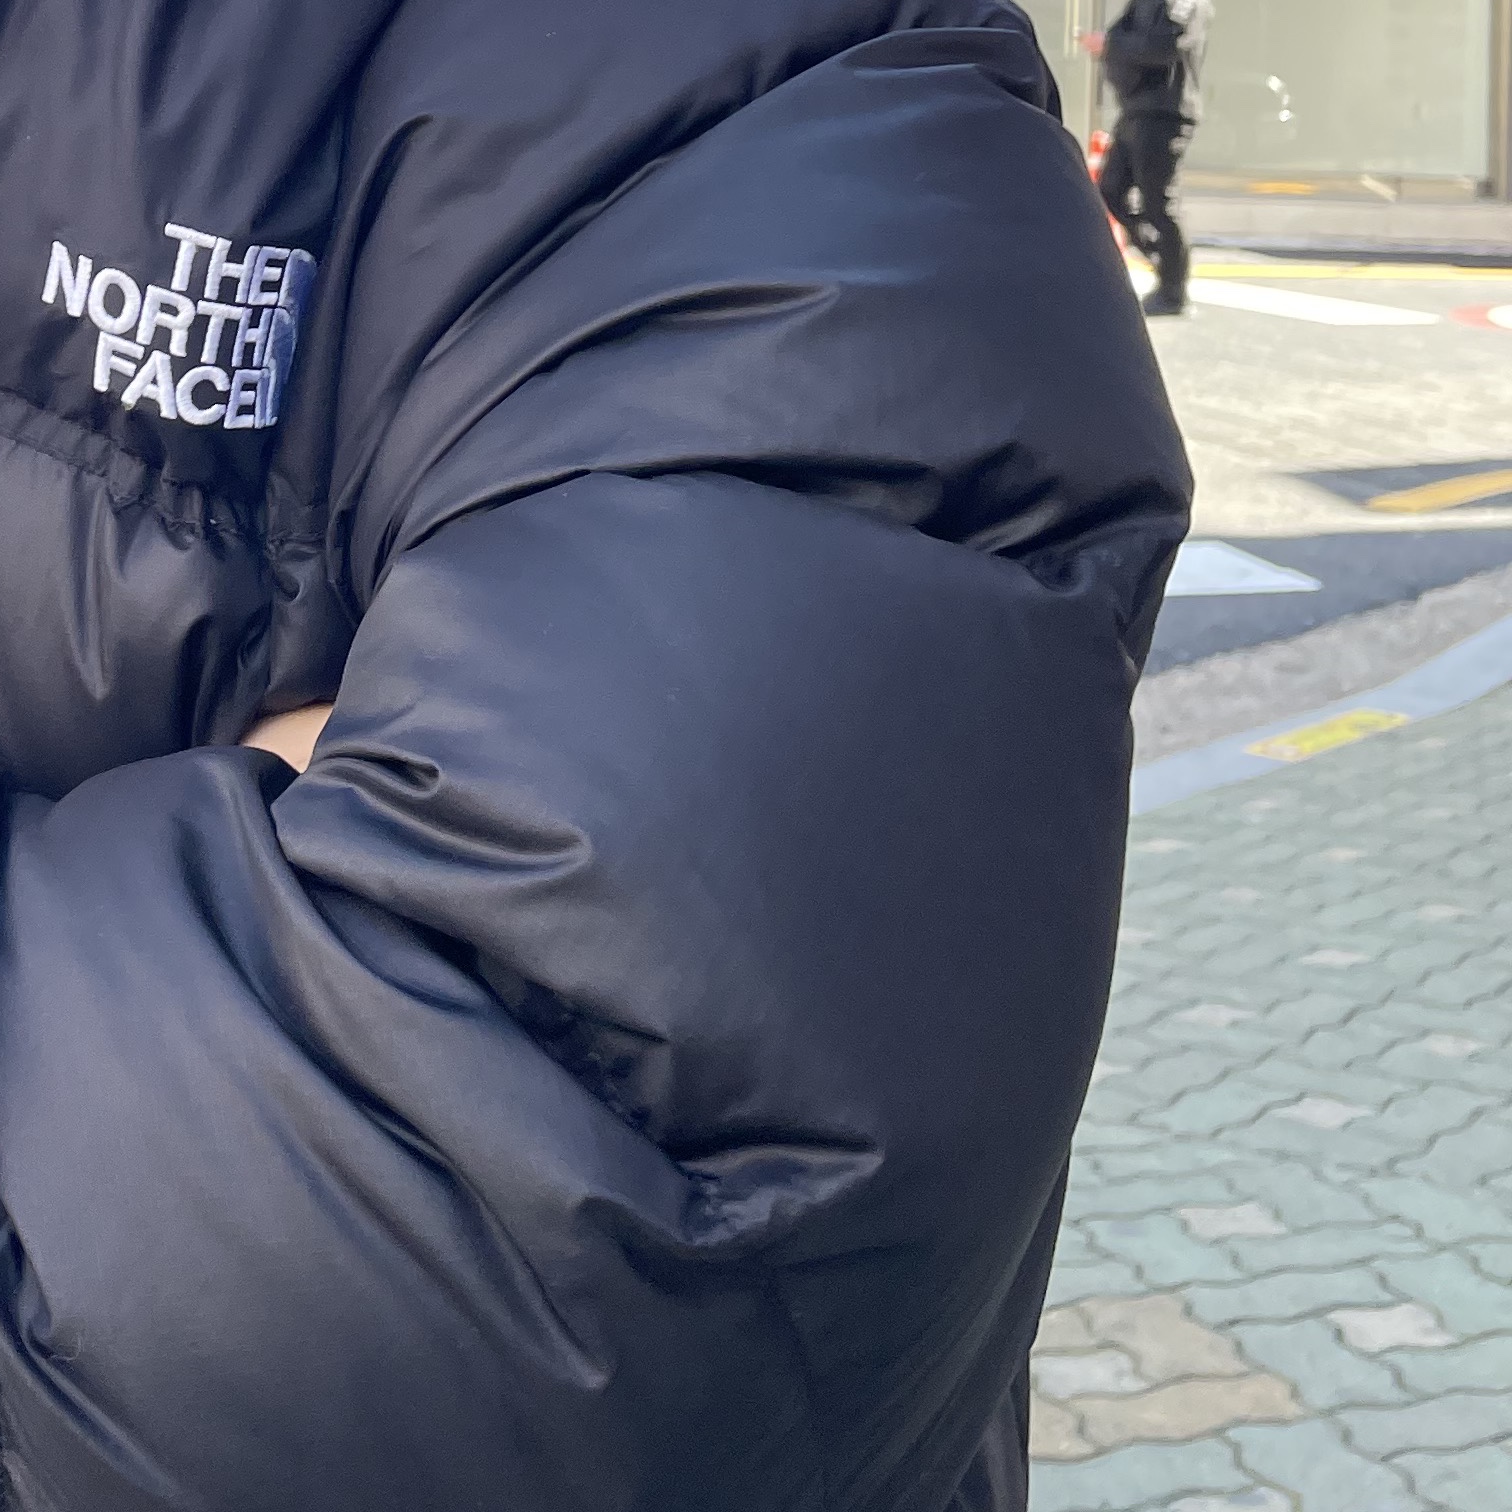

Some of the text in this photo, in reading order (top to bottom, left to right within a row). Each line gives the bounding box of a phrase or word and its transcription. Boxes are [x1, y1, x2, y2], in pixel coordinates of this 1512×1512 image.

[41, 240, 271, 368] NORTH
[164, 222, 291, 306] THE
[93, 331, 258, 430] FACE
